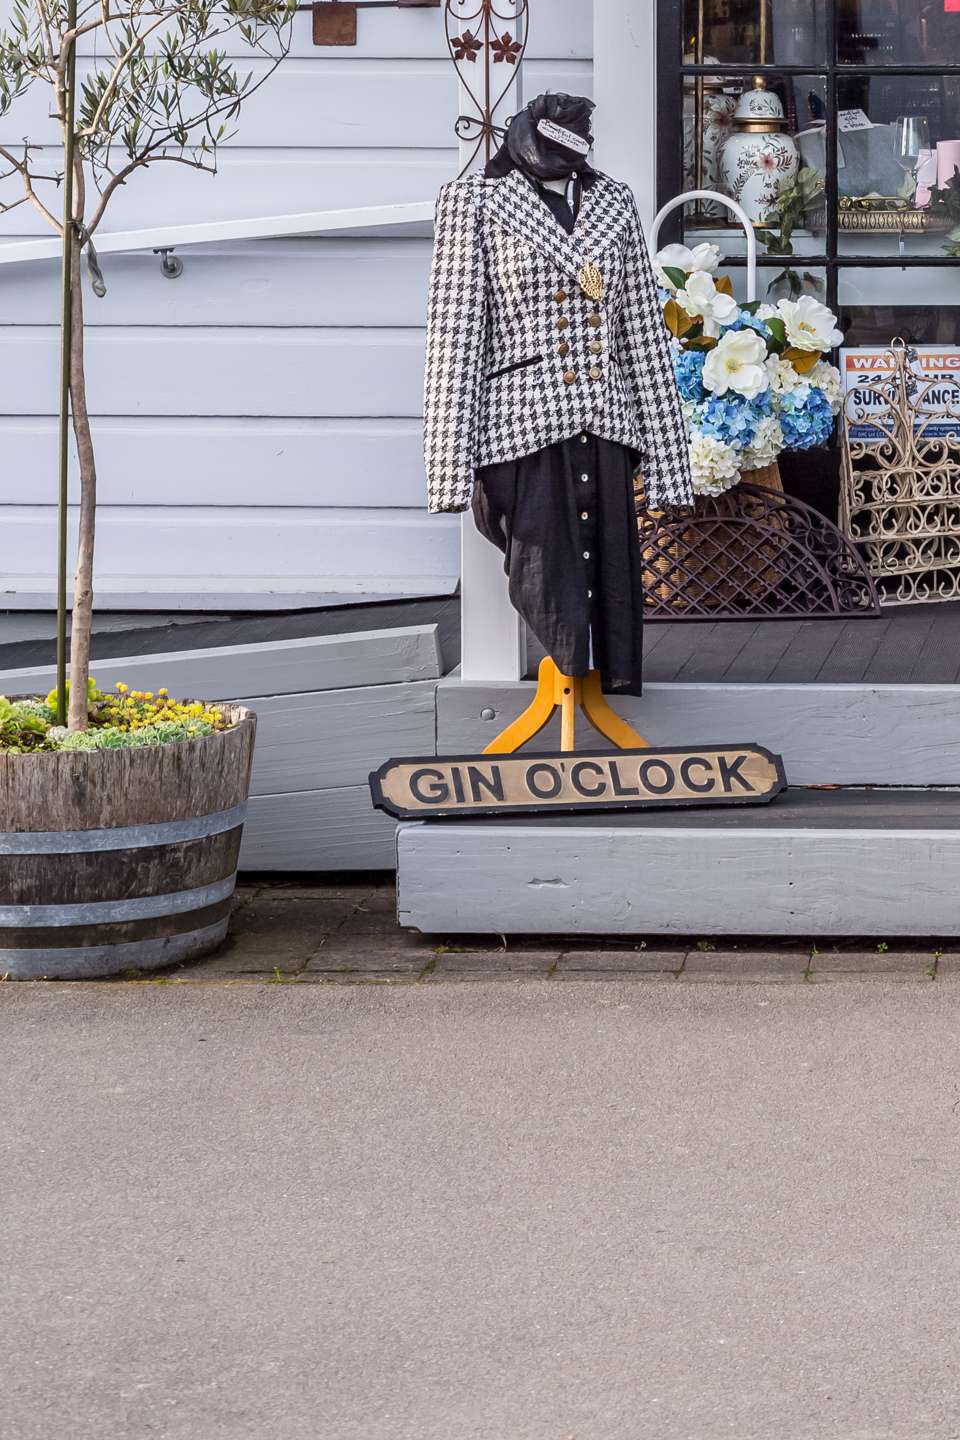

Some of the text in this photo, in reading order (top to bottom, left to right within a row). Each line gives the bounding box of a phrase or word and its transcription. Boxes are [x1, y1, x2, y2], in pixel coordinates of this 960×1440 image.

[853, 356, 960, 369] WAING
[409, 754, 755, 804] GIN O'CLOCK
